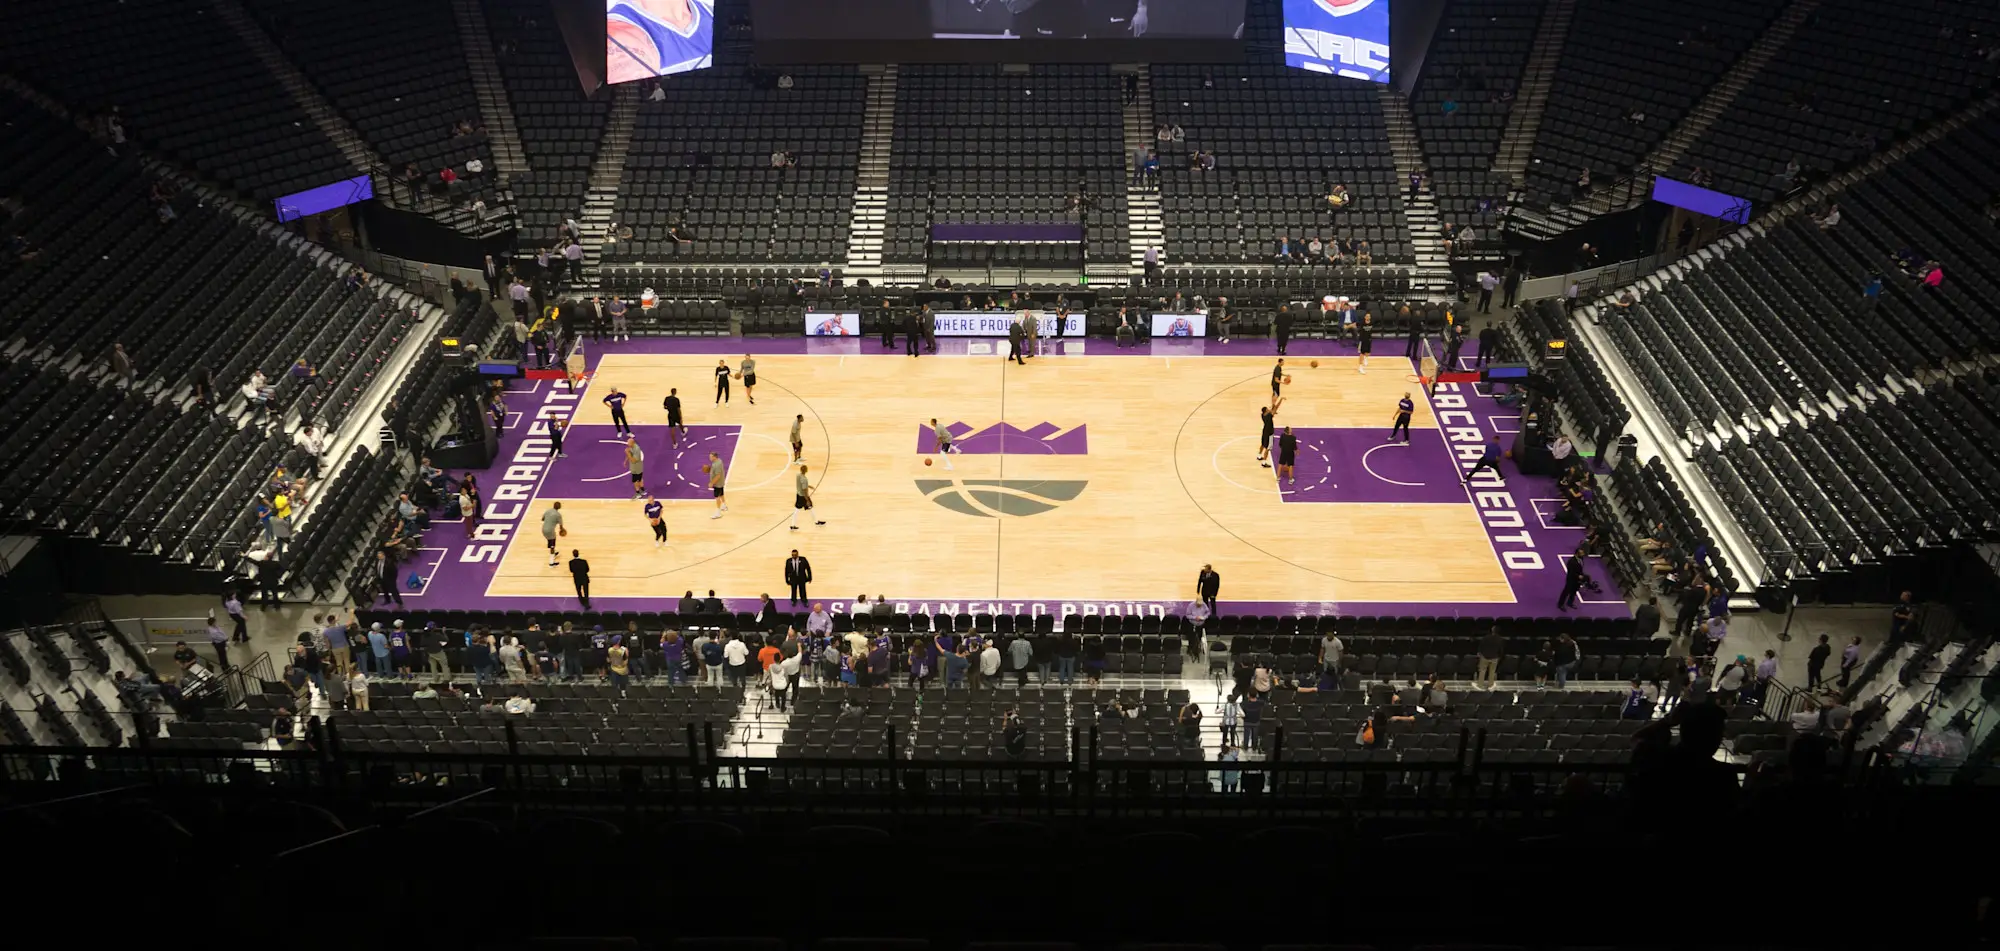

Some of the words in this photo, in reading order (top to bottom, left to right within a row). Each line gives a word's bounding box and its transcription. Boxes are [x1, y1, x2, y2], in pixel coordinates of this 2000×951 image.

[1284, 27, 1390, 72] SAC
[934, 319, 975, 331] WHERE
[980, 319, 1021, 331] PROU
[1433, 382, 1545, 569] SACRAMENTO
[830, 602, 1046, 625] SRAMENTO
